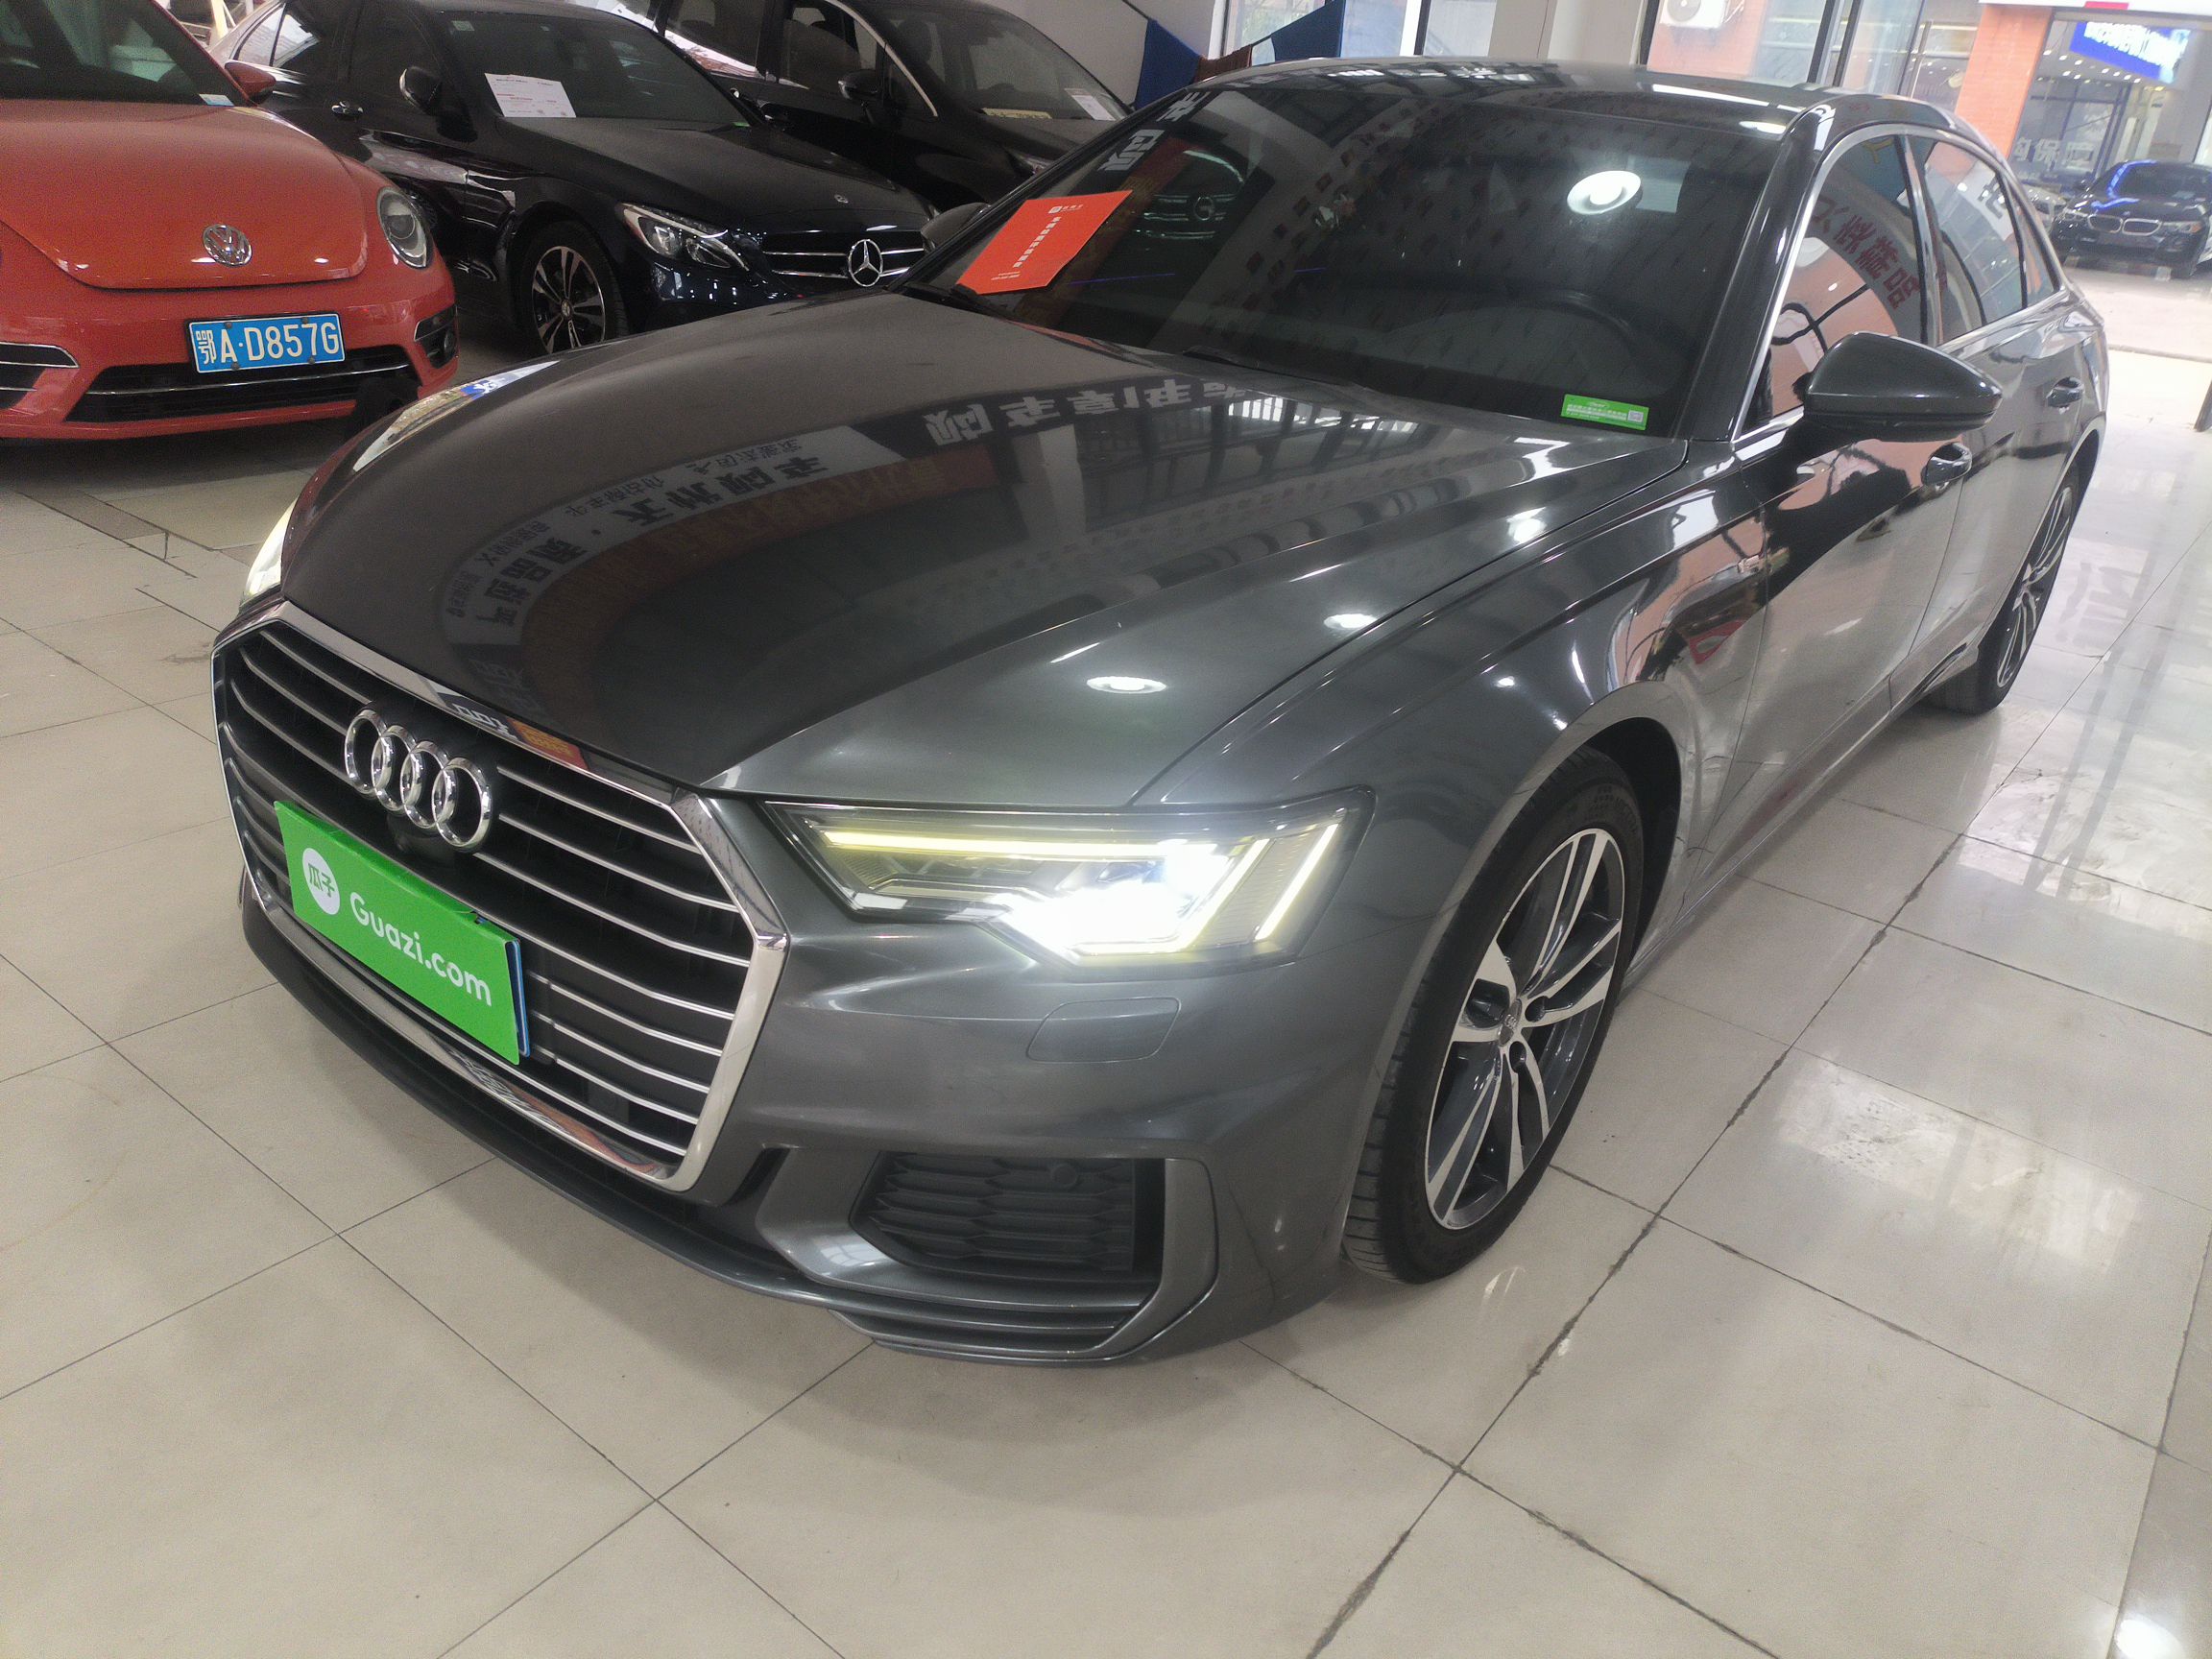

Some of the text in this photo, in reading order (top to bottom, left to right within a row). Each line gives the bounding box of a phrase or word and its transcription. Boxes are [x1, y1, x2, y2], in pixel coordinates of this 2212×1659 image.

[195, 322, 340, 365] 鄂A·D857G
[307, 863, 335, 898] 瓜子
[349, 891, 493, 1007] Guazi.com
